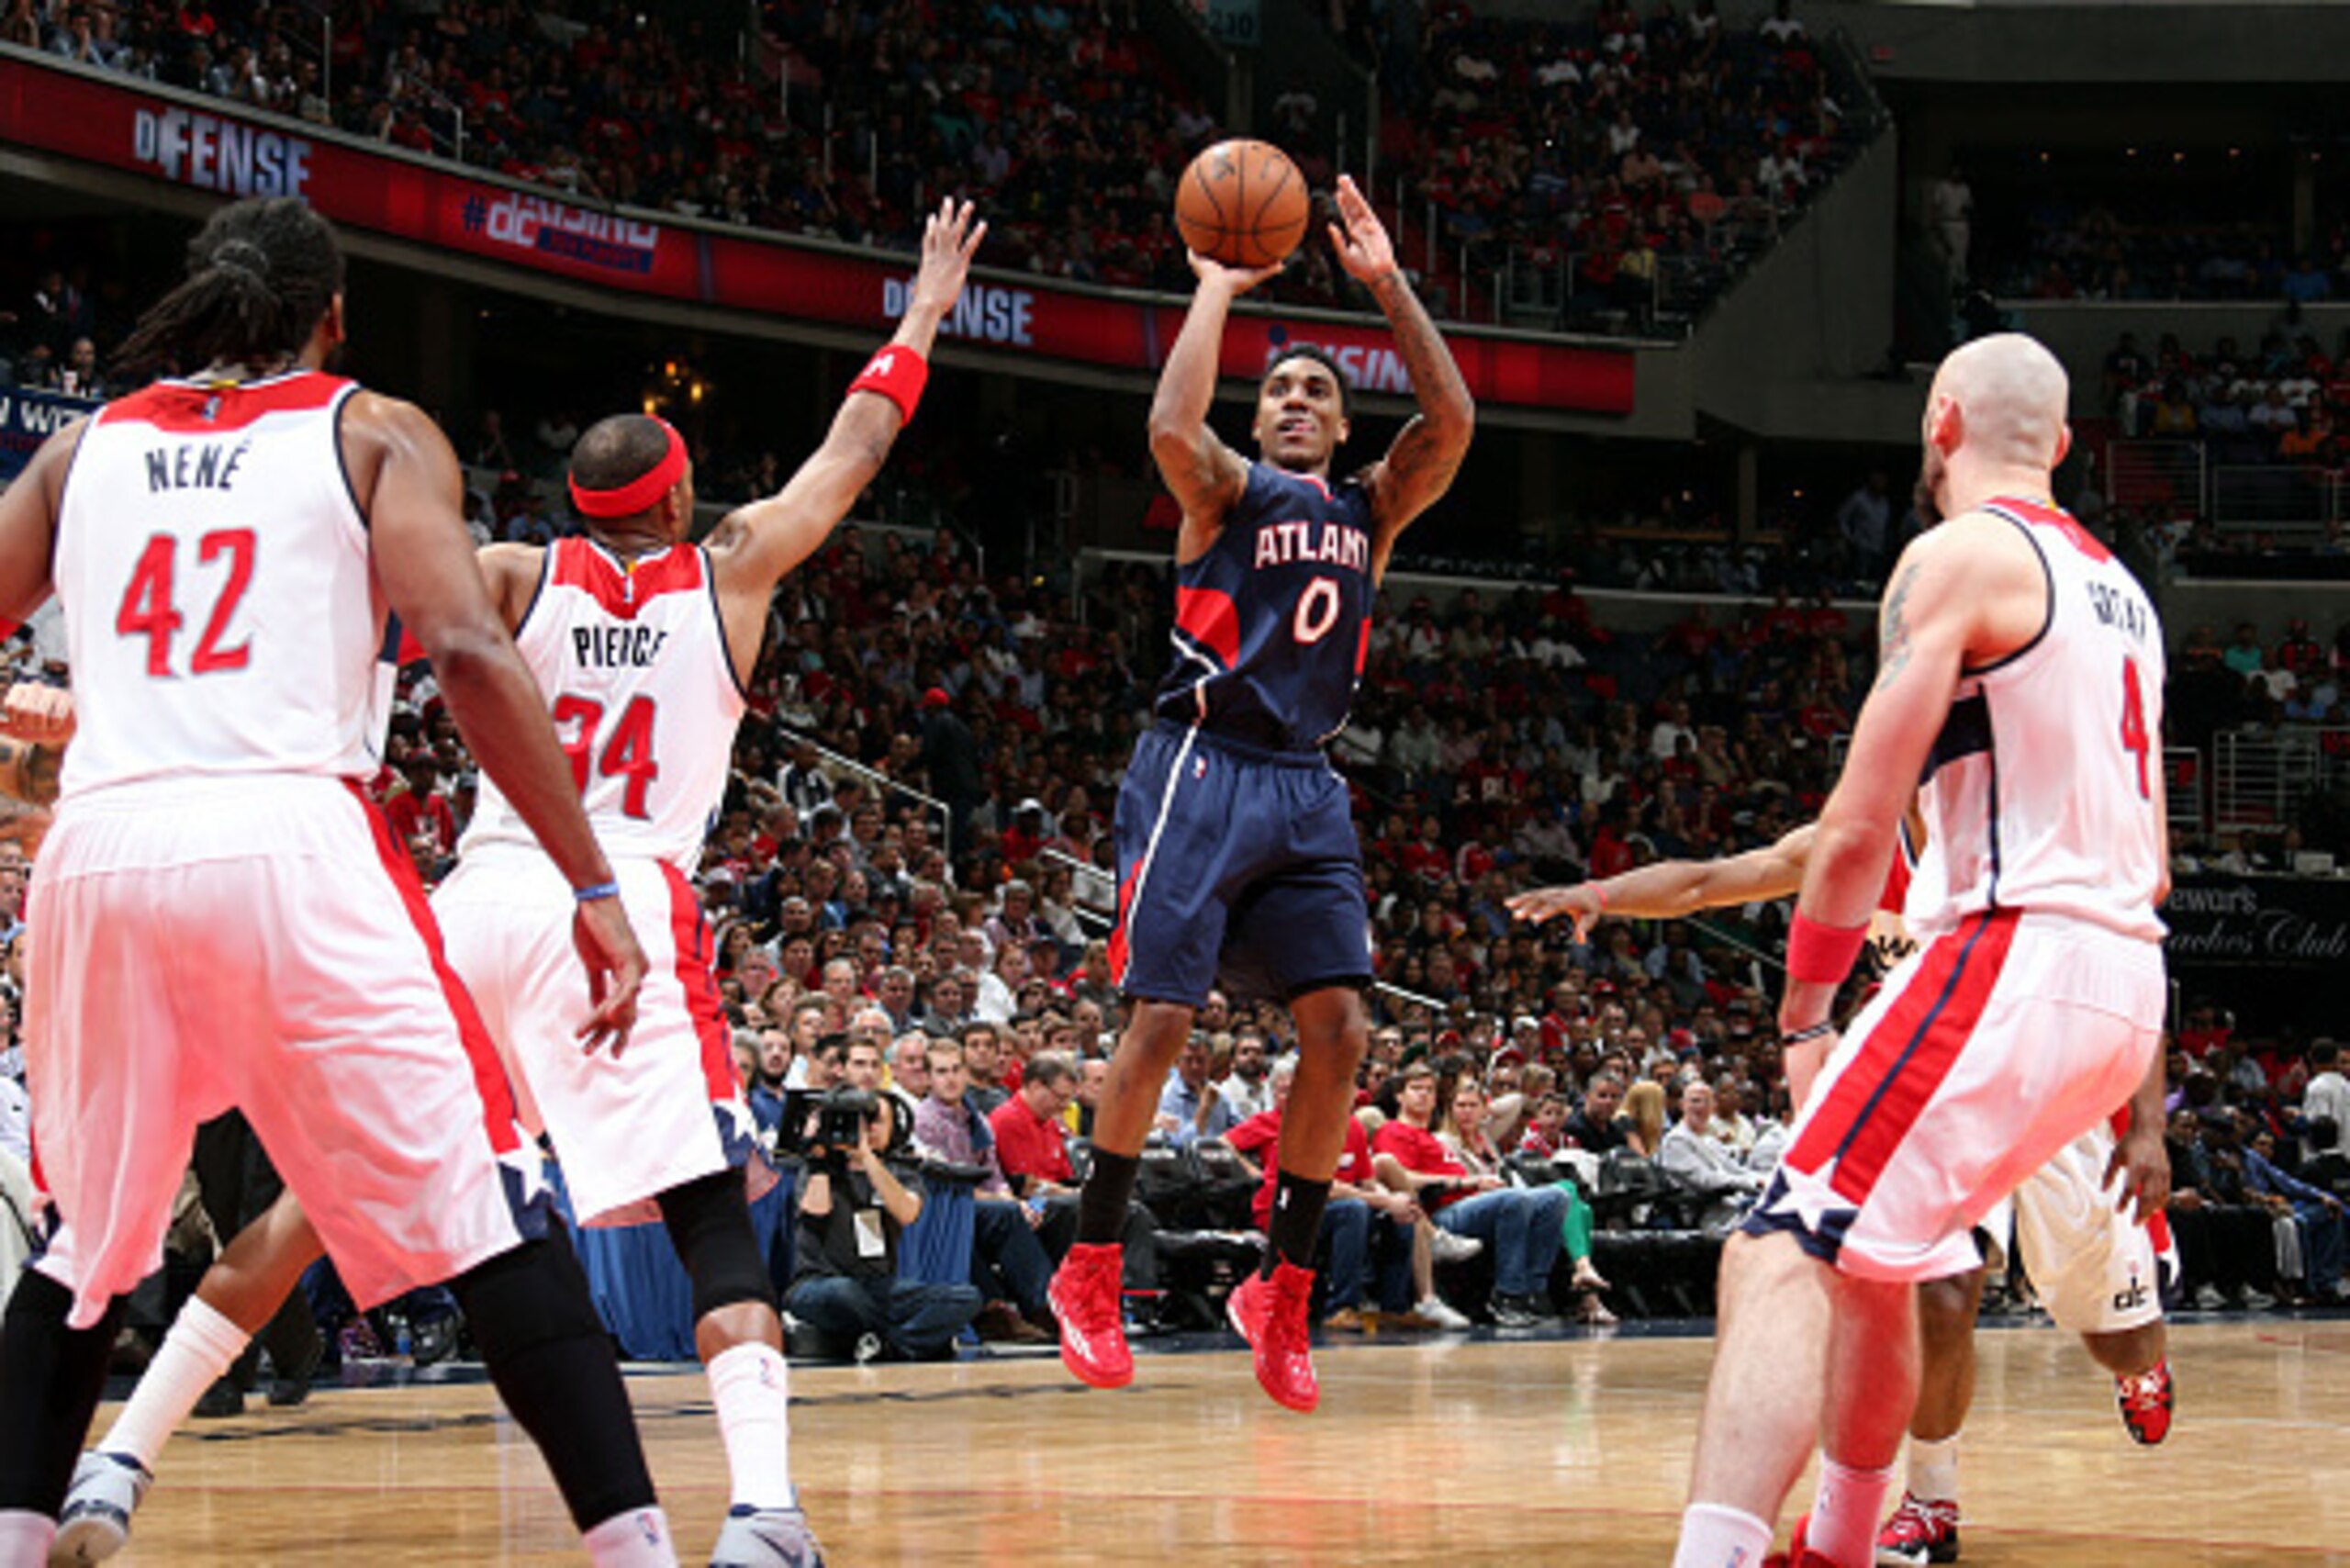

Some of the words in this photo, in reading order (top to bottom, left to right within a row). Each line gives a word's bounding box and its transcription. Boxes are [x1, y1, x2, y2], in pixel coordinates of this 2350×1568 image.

[115, 527, 257, 678] 42
[1293, 575, 1340, 644] 0
[2121, 655, 2150, 801] 4
[2169, 885, 2258, 913] ewar's
